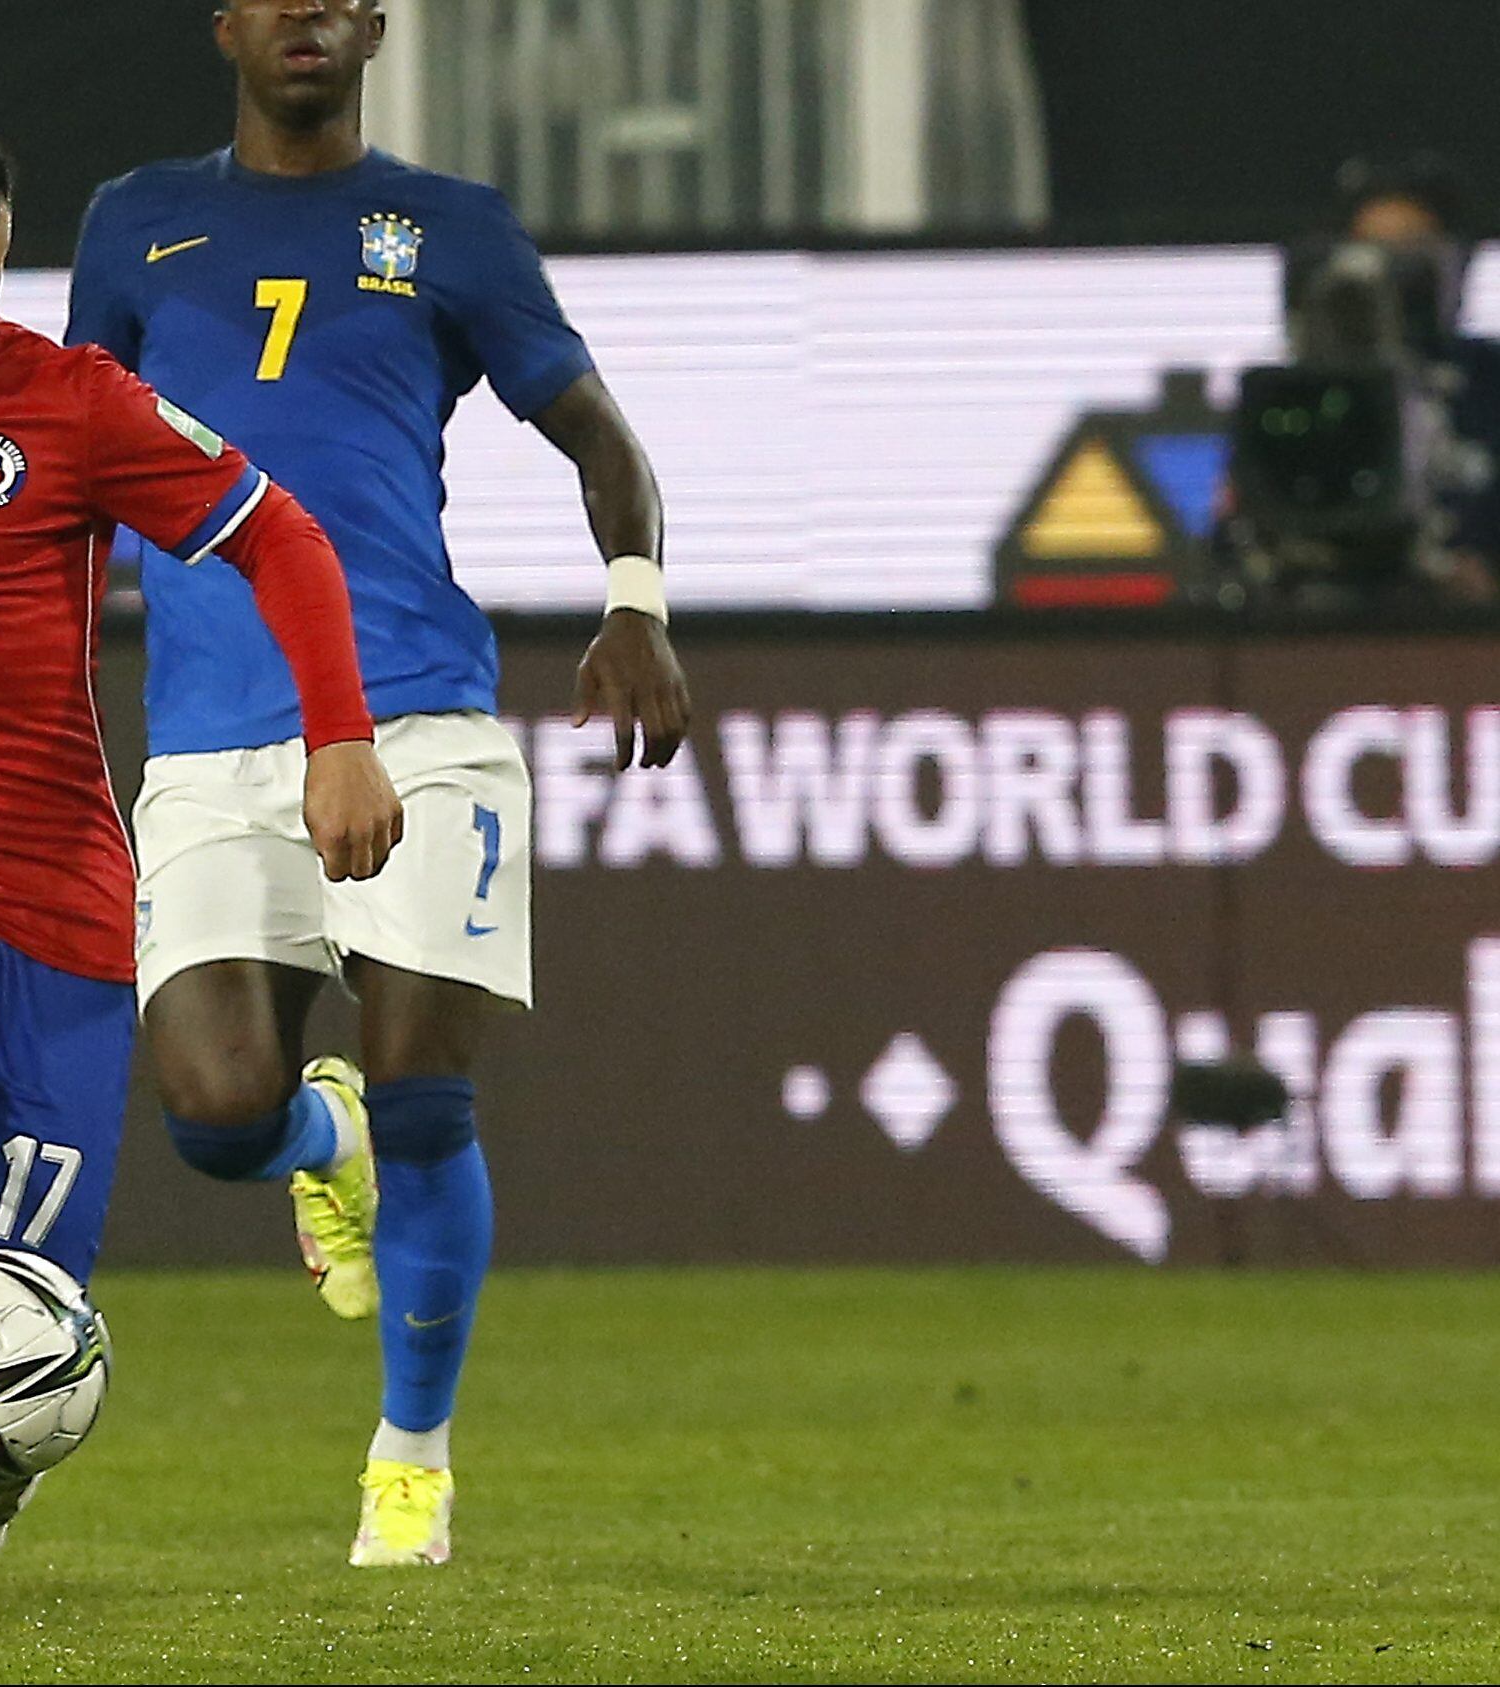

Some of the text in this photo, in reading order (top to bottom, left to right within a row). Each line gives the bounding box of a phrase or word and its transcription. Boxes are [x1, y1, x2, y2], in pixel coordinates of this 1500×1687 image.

[255, 279, 307, 381] 7
[357, 275, 417, 297] BRASIL
[718, 708, 1286, 870] WORLD
[472, 803, 500, 899] 7
